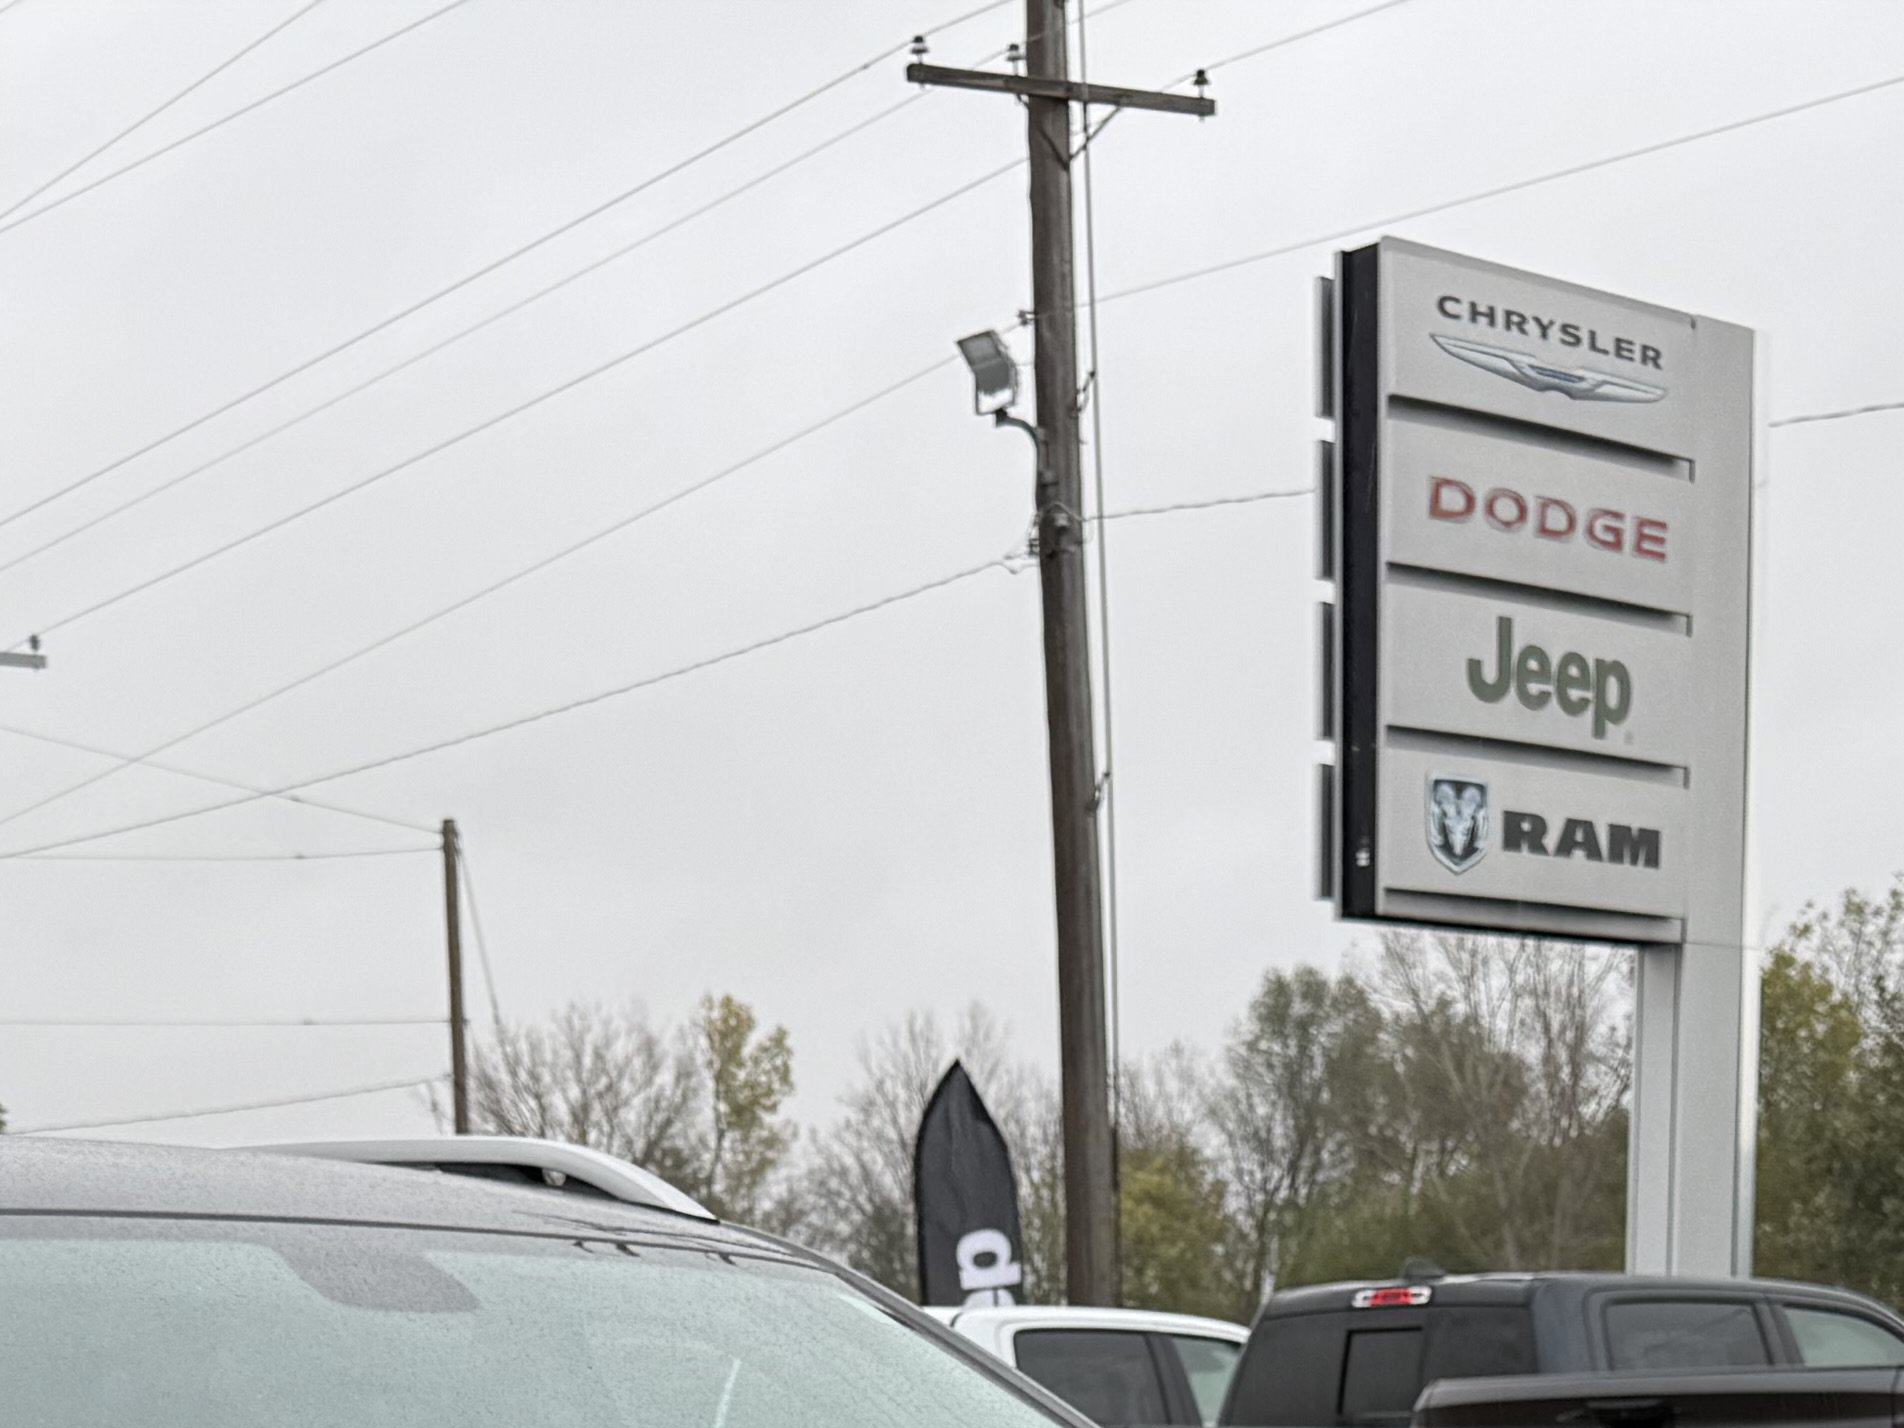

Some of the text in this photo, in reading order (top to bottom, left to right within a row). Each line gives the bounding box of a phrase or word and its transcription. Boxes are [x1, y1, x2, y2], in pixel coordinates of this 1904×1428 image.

[1437, 295, 1663, 370] CHRYSLER
[1428, 475, 1669, 563] DODGE
[1467, 616, 1633, 739] Jeep
[1502, 809, 1661, 869] RAM
